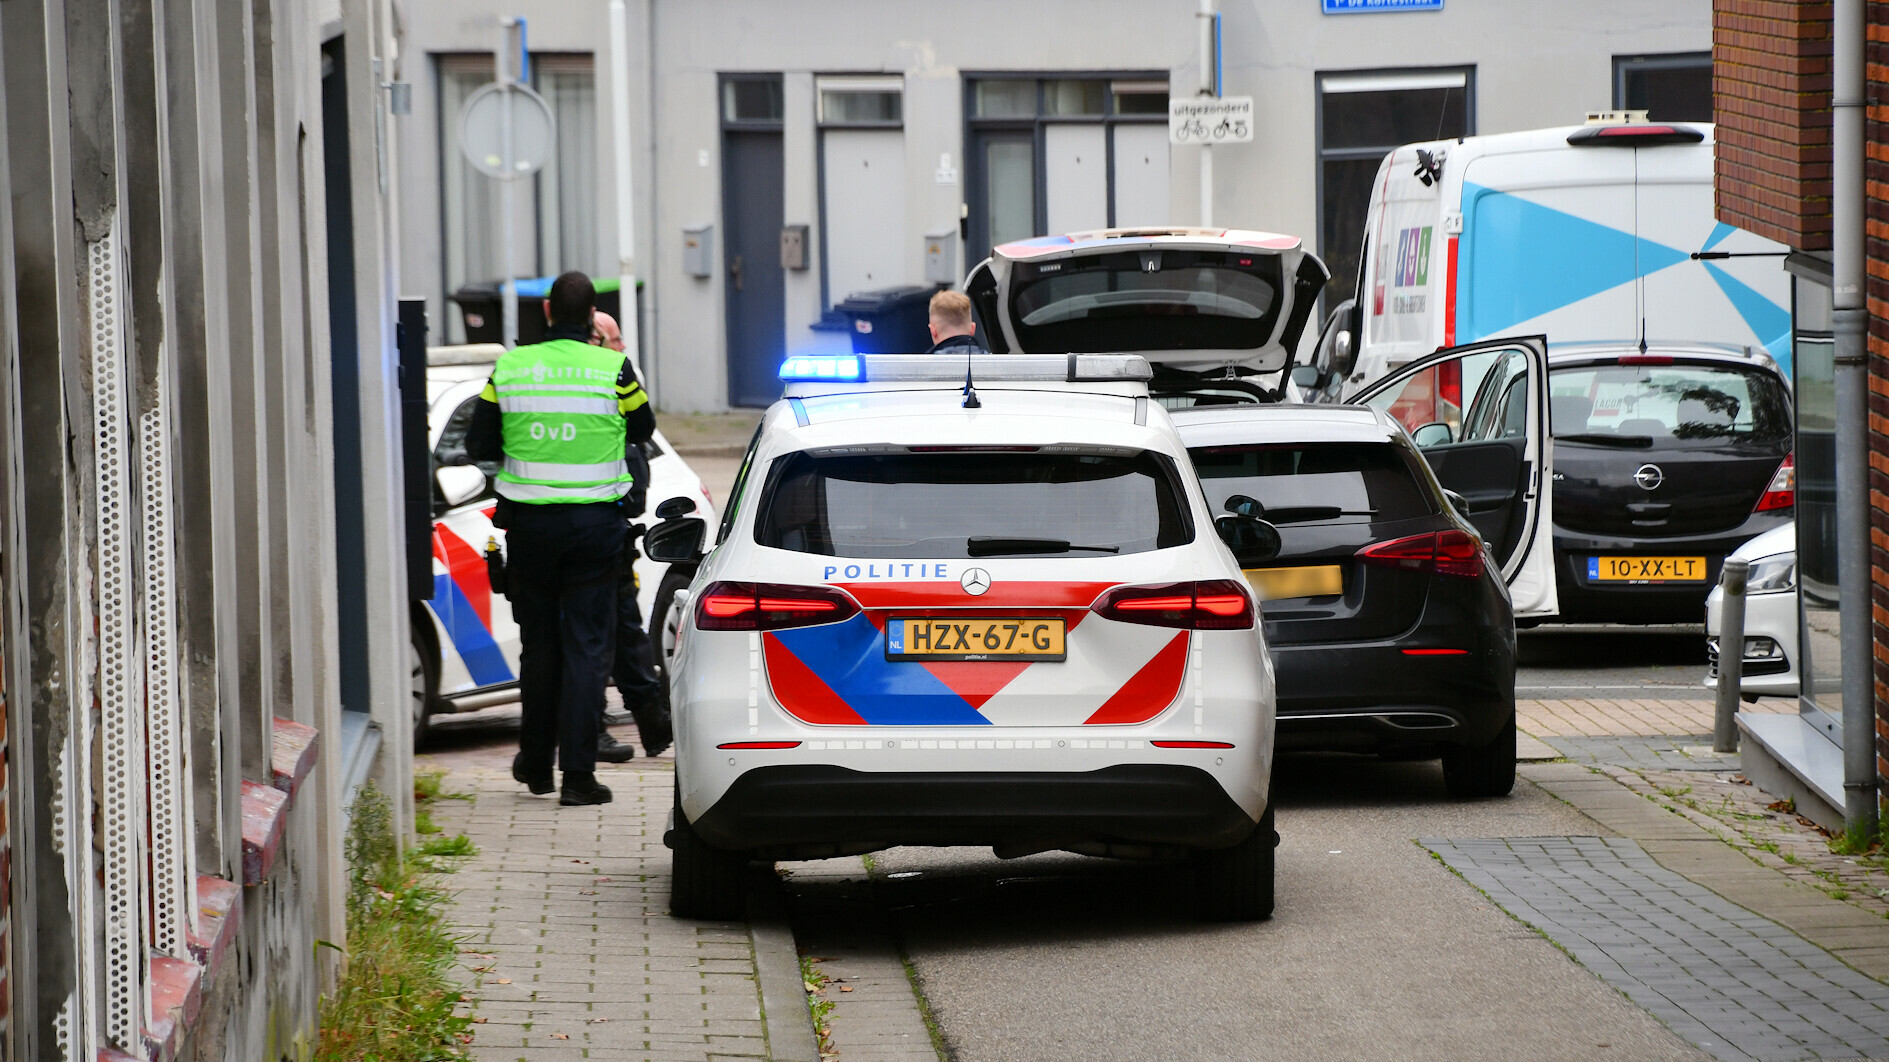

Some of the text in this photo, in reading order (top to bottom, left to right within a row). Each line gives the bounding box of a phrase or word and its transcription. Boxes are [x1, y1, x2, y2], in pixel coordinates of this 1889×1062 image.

[1348, 0, 1363, 8] De
[1174, 103, 1249, 118] uitgezonderd
[530, 422, 576, 442] OvD
[824, 563, 947, 580] POLITIE
[1610, 560, 1696, 576] 10-XX-LT
[890, 641, 902, 649] NL
[913, 624, 1050, 650] HZX-67-G
